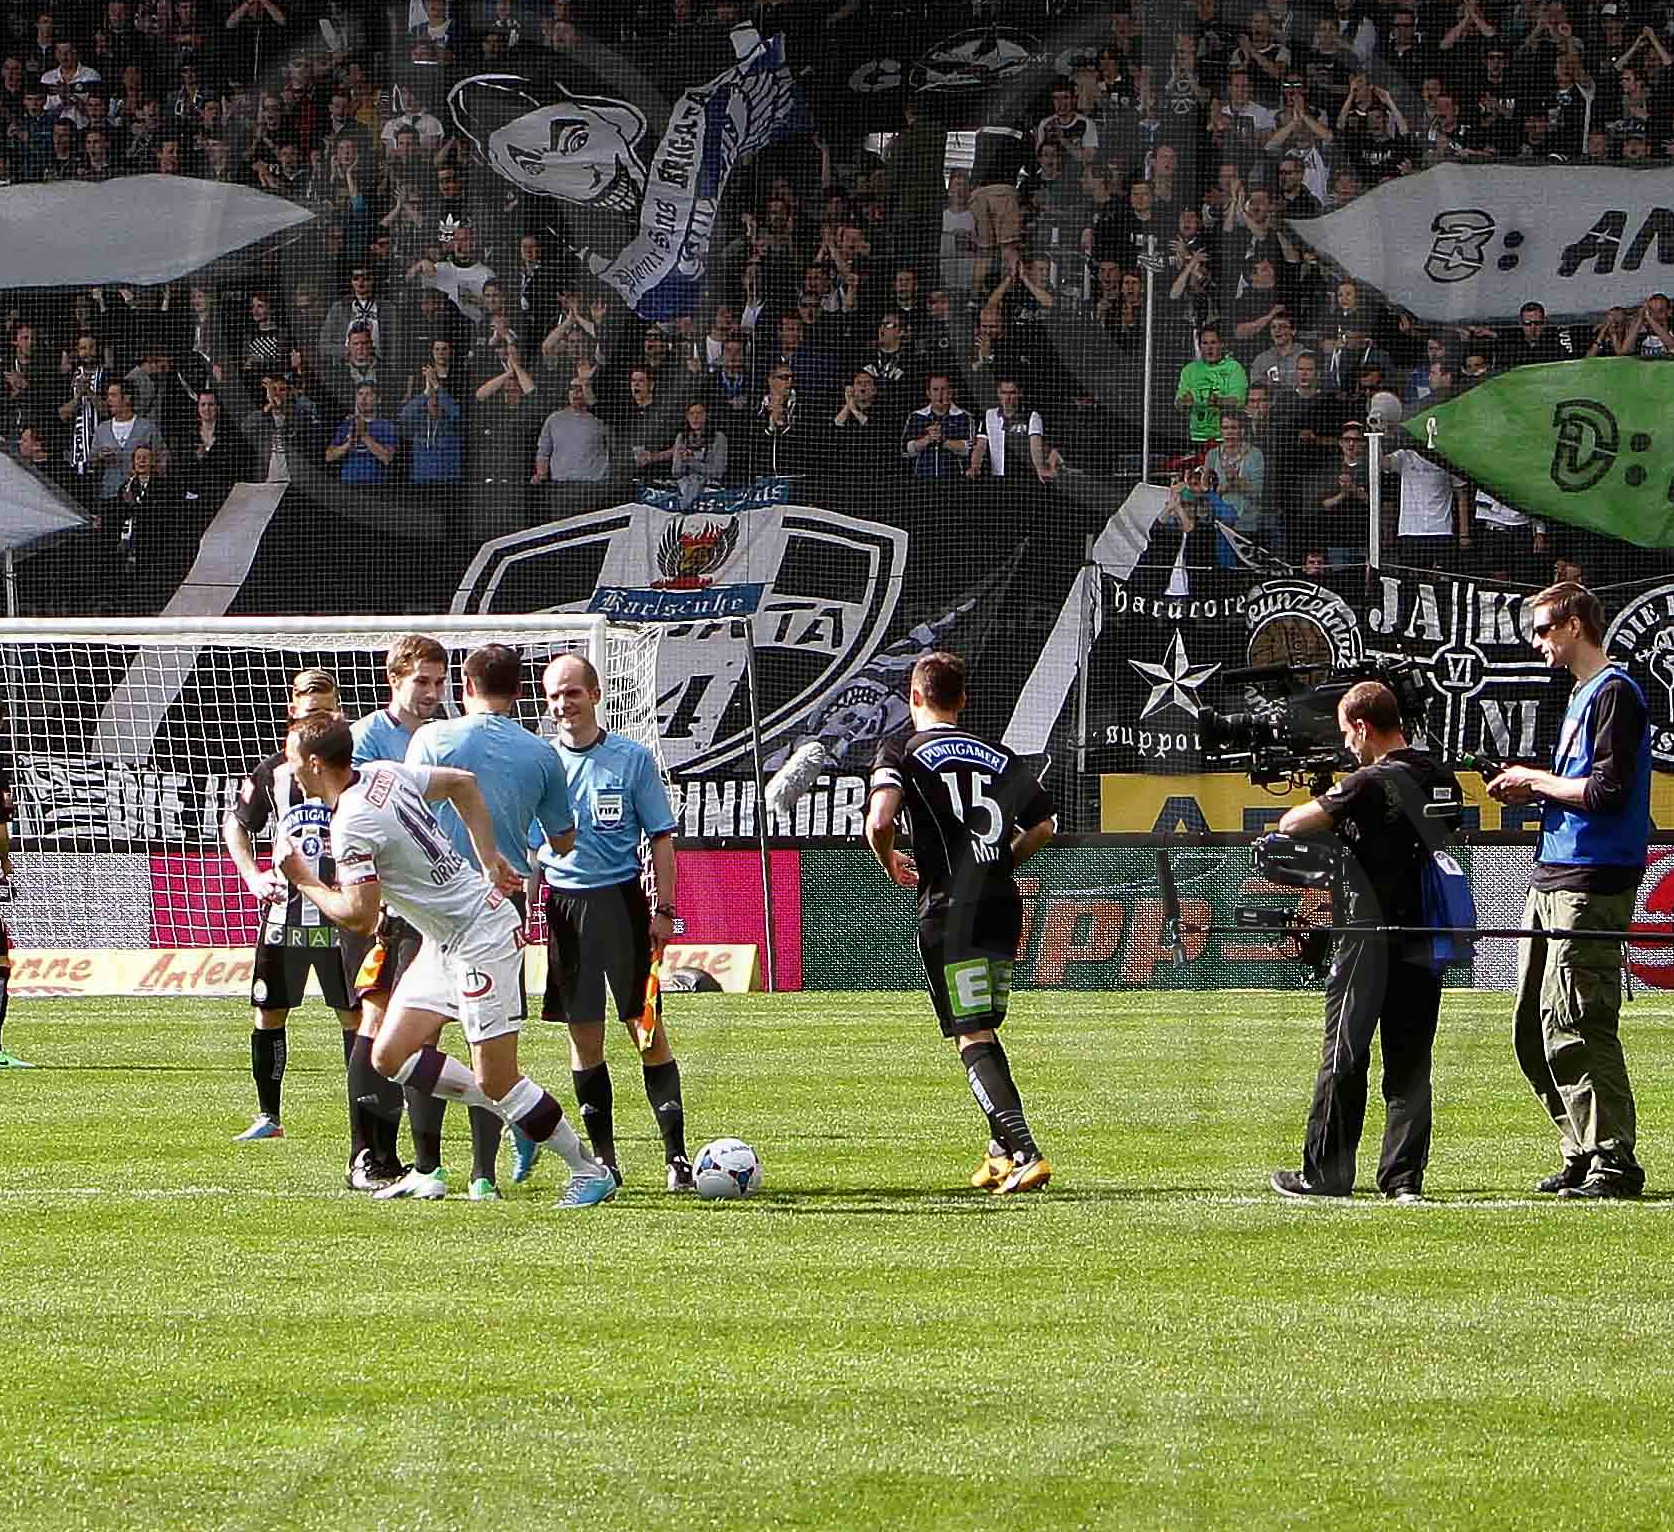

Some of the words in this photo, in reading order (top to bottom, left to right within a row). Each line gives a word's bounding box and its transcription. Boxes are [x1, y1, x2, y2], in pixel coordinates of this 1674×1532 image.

[1549, 398, 1652, 493] D:
[1615, 601, 1663, 651] DIE
[1445, 654, 1476, 687] VI
[923, 739, 1001, 768] PUNTIGAMER
[598, 805, 620, 817] FIFA
[940, 771, 1004, 845] 15
